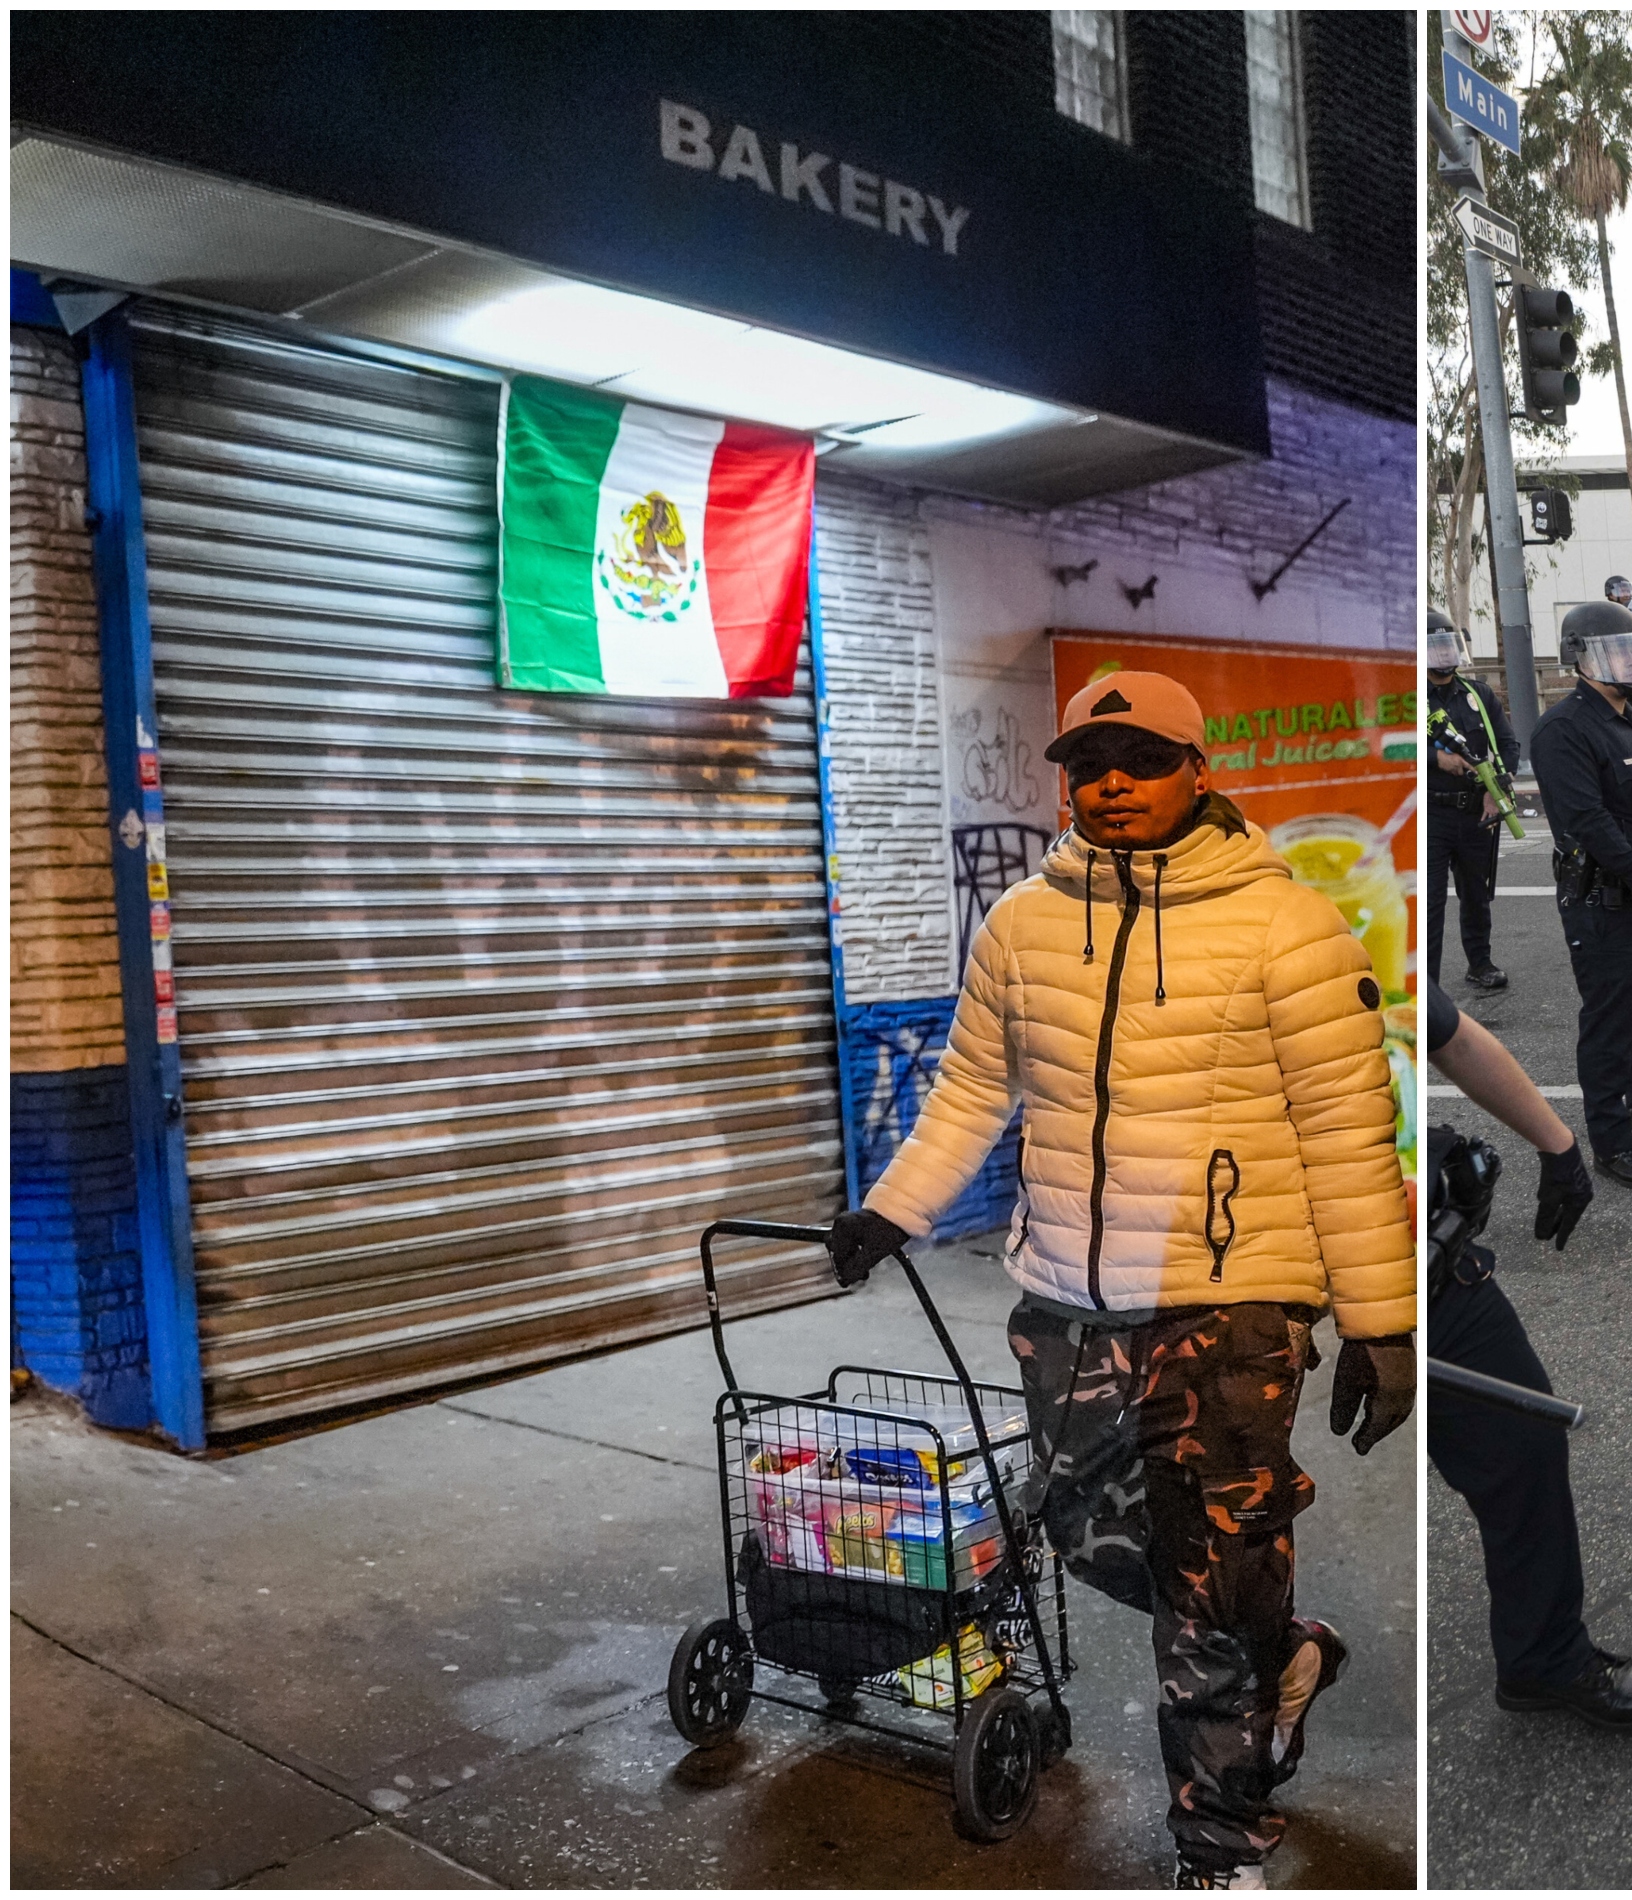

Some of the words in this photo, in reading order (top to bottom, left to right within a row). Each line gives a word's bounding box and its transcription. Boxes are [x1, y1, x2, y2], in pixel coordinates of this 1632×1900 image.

[1457, 71, 1508, 131] Main
[660, 98, 971, 255] BAKERY
[1473, 215, 1492, 242] ONE
[1494, 223, 1515, 252] WAY
[1205, 690, 1418, 744] NATURALES
